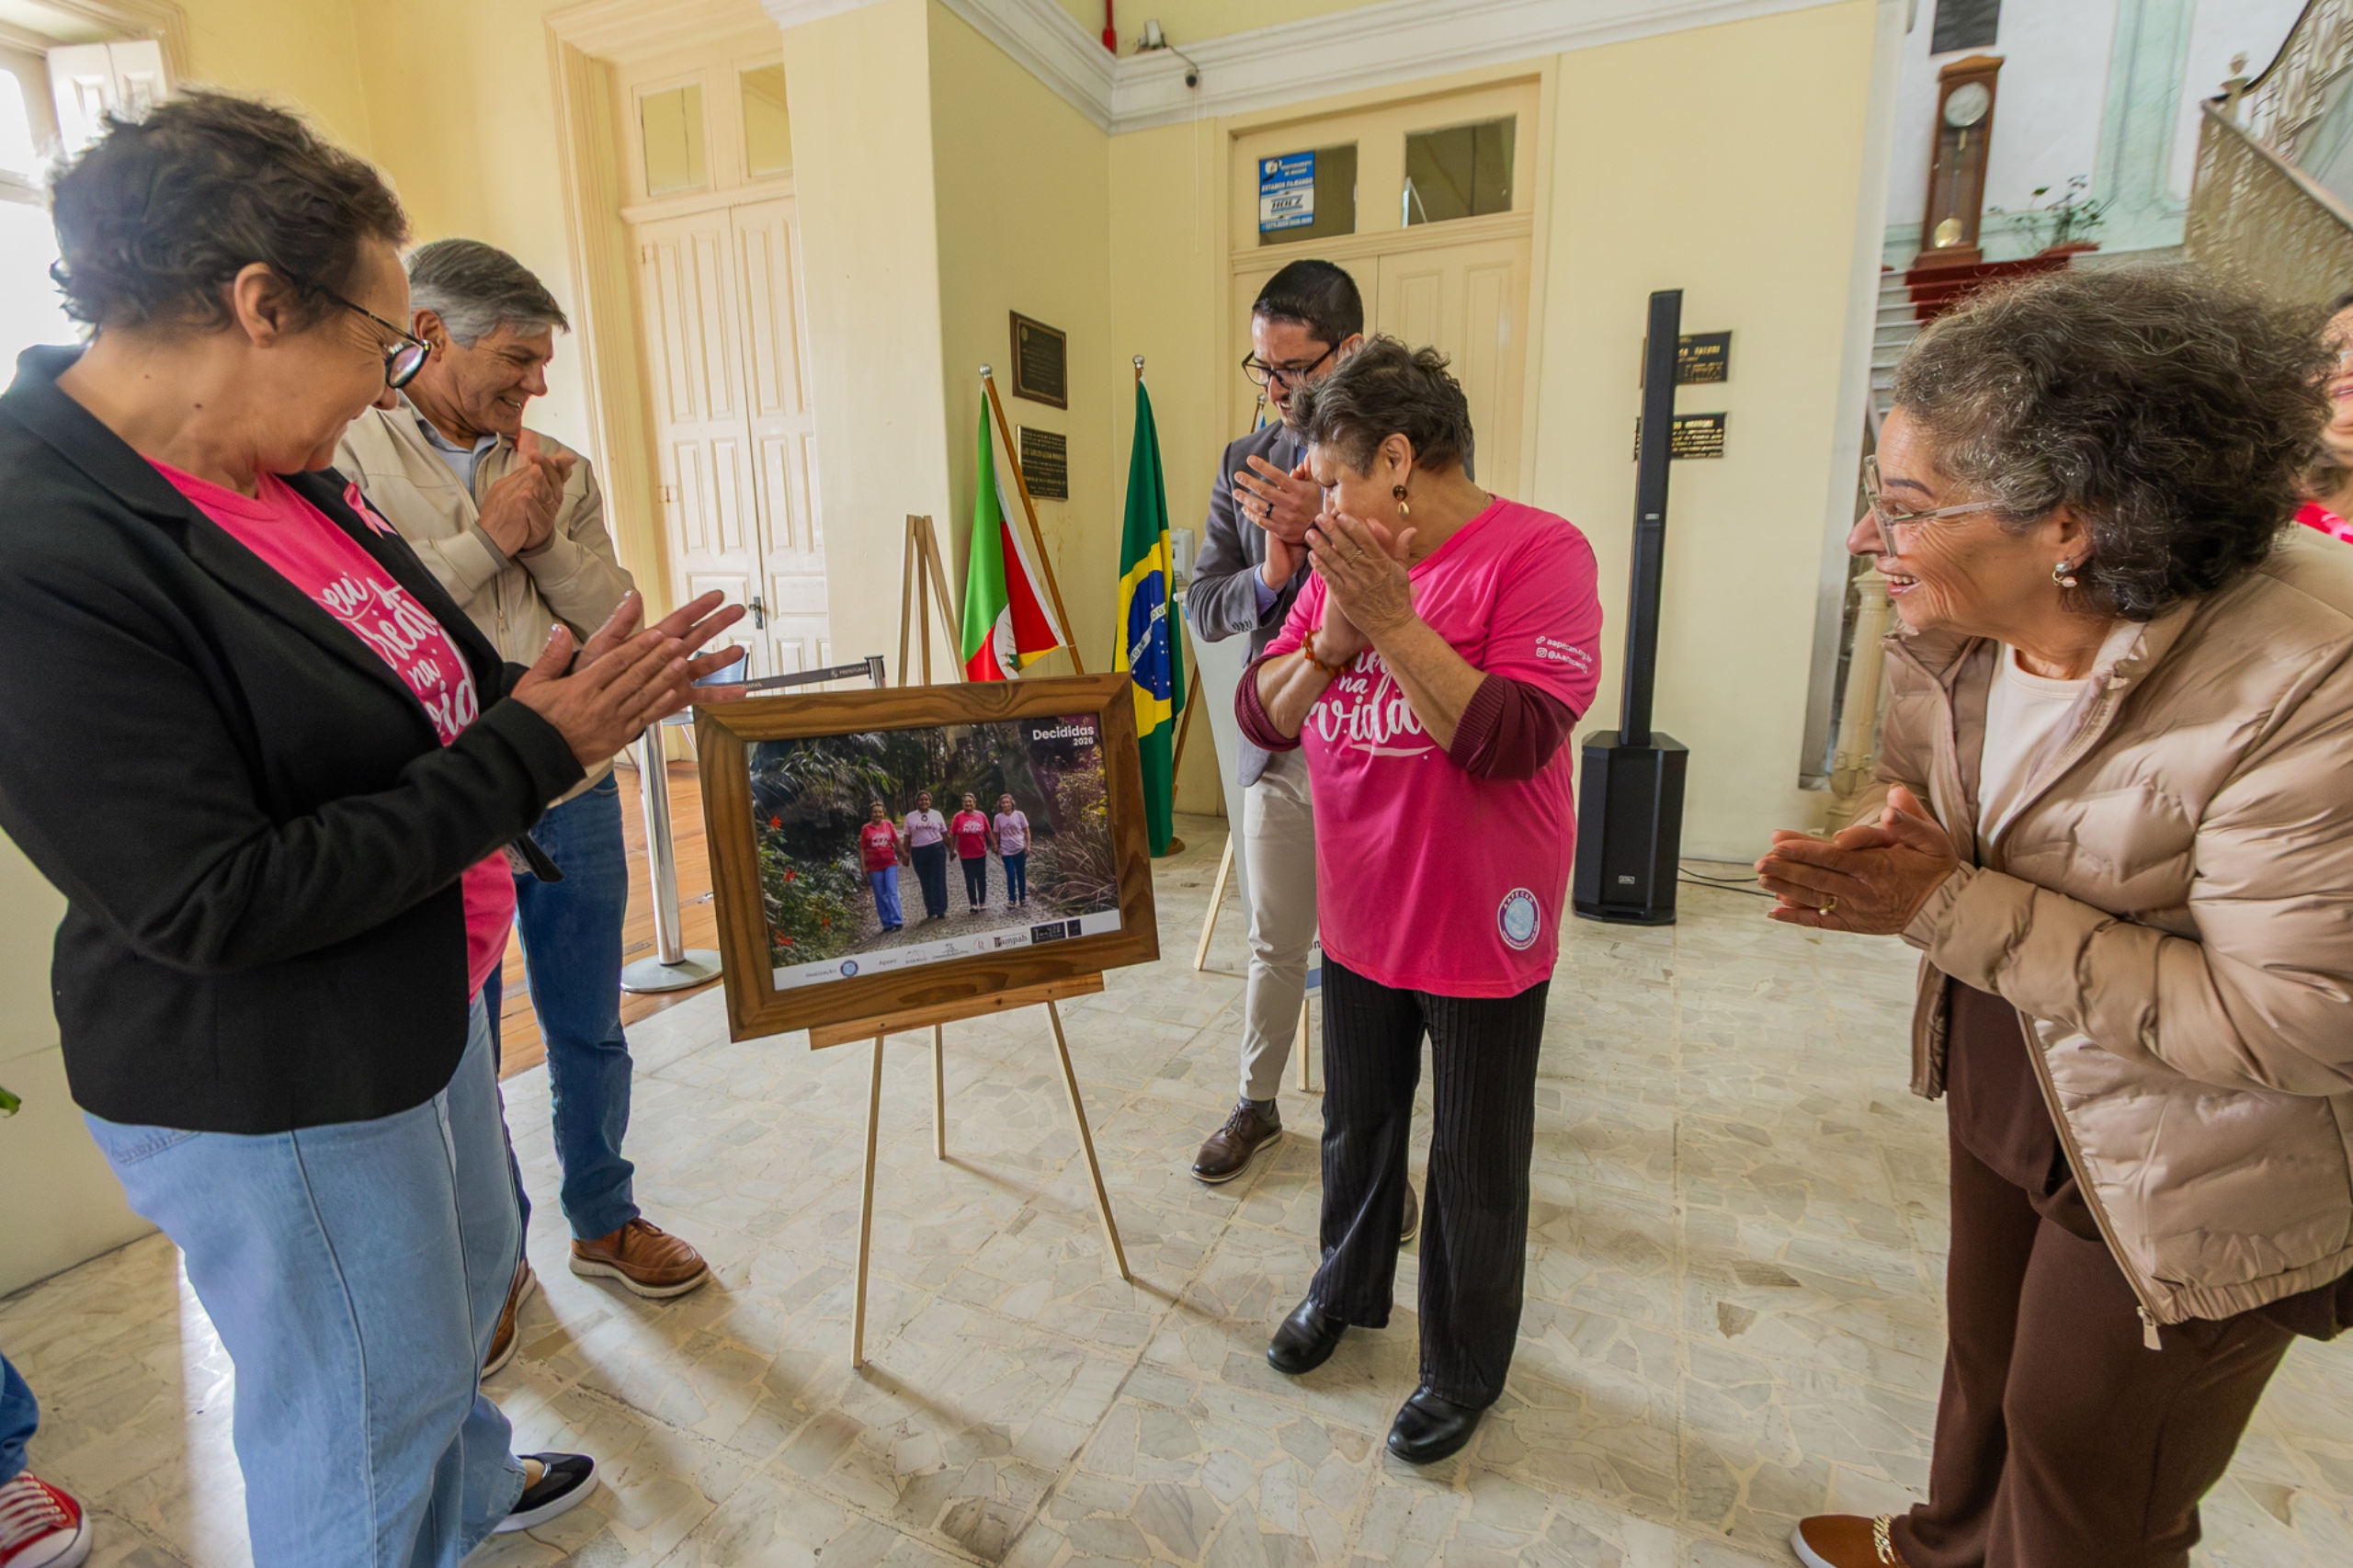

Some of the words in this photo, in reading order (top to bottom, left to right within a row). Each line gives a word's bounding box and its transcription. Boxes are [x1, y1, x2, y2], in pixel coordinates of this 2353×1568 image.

[407, 658, 441, 690] na
[1338, 676, 1369, 694] na
[1304, 674, 1423, 744] vida
[1032, 724, 1095, 741] Decididas
[1504, 892, 1533, 910] AAPECAN
